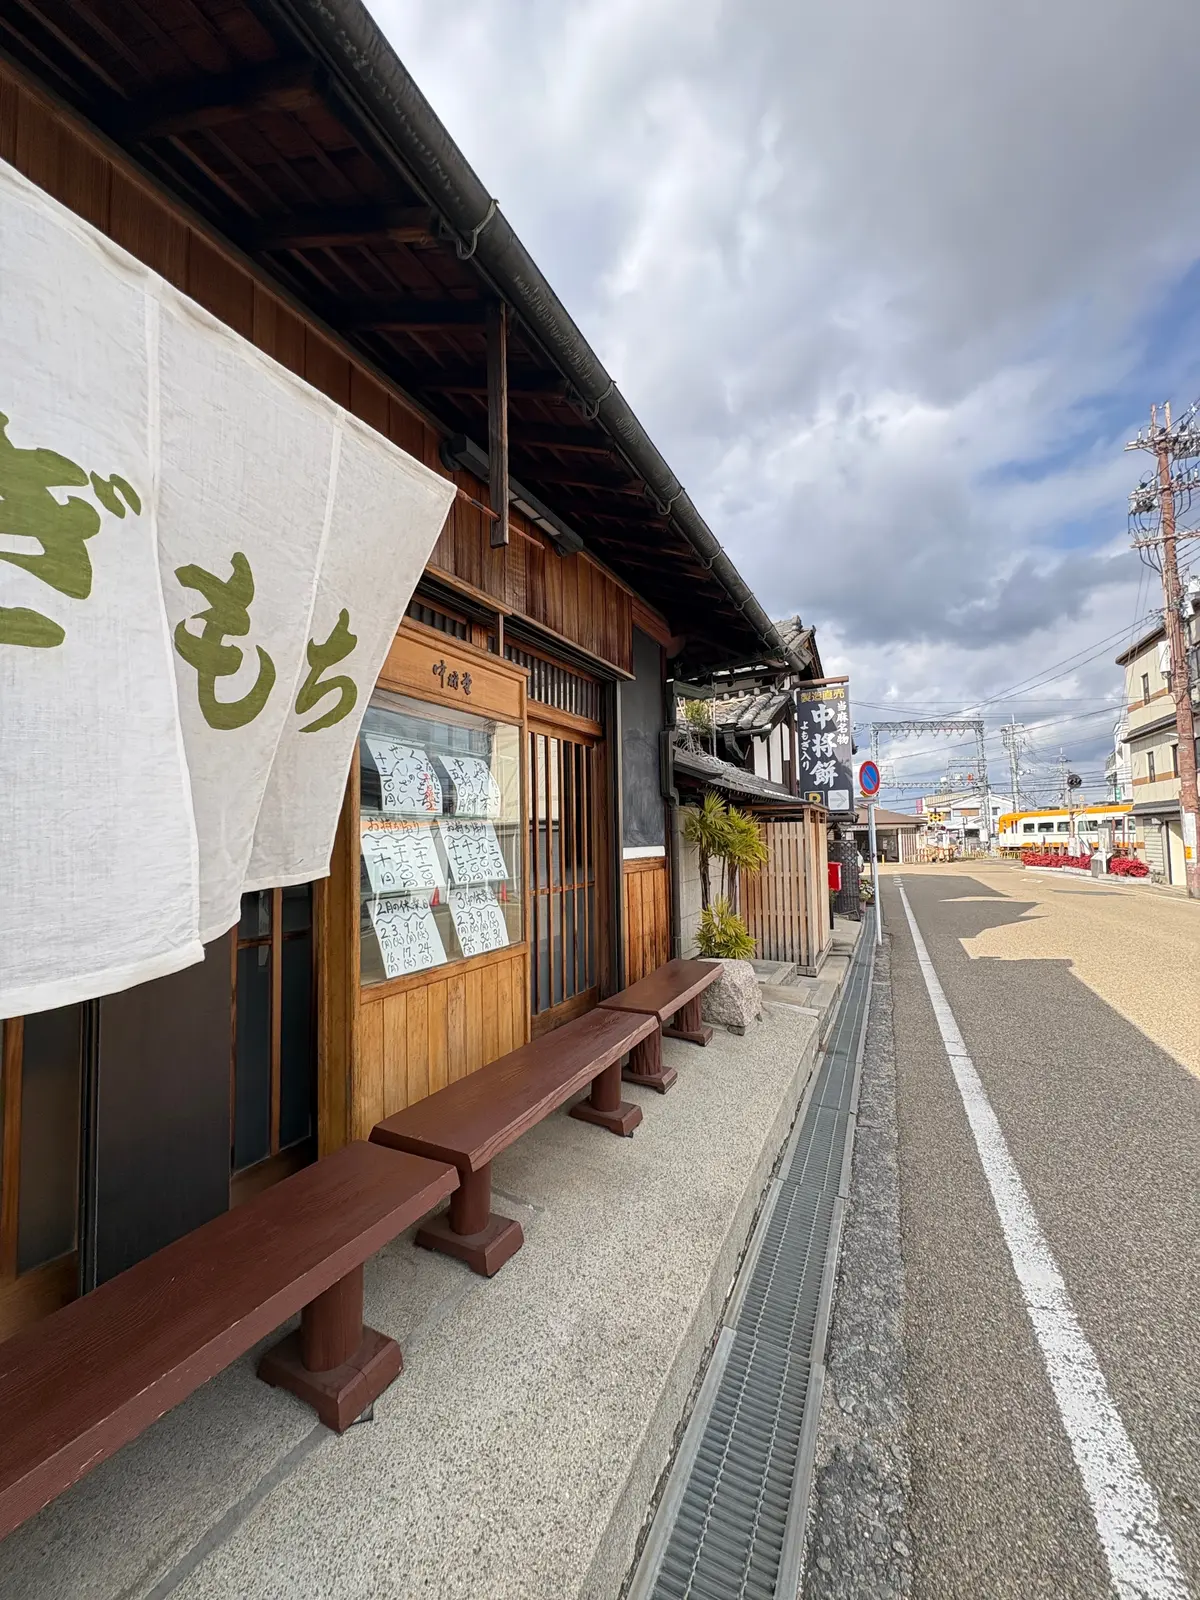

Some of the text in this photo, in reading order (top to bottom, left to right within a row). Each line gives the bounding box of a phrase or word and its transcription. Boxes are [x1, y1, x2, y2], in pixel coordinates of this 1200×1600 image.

[800, 688, 845, 702] 製造直売
[836, 701, 850, 745] 当麻名物
[800, 721, 812, 771] よもぎ入り
[809, 704, 839, 788] 中将餅
[808, 792, 821, 804] P
[367, 817, 421, 835] お持ち帰り
[376, 898, 429, 916] 2月の休業日
